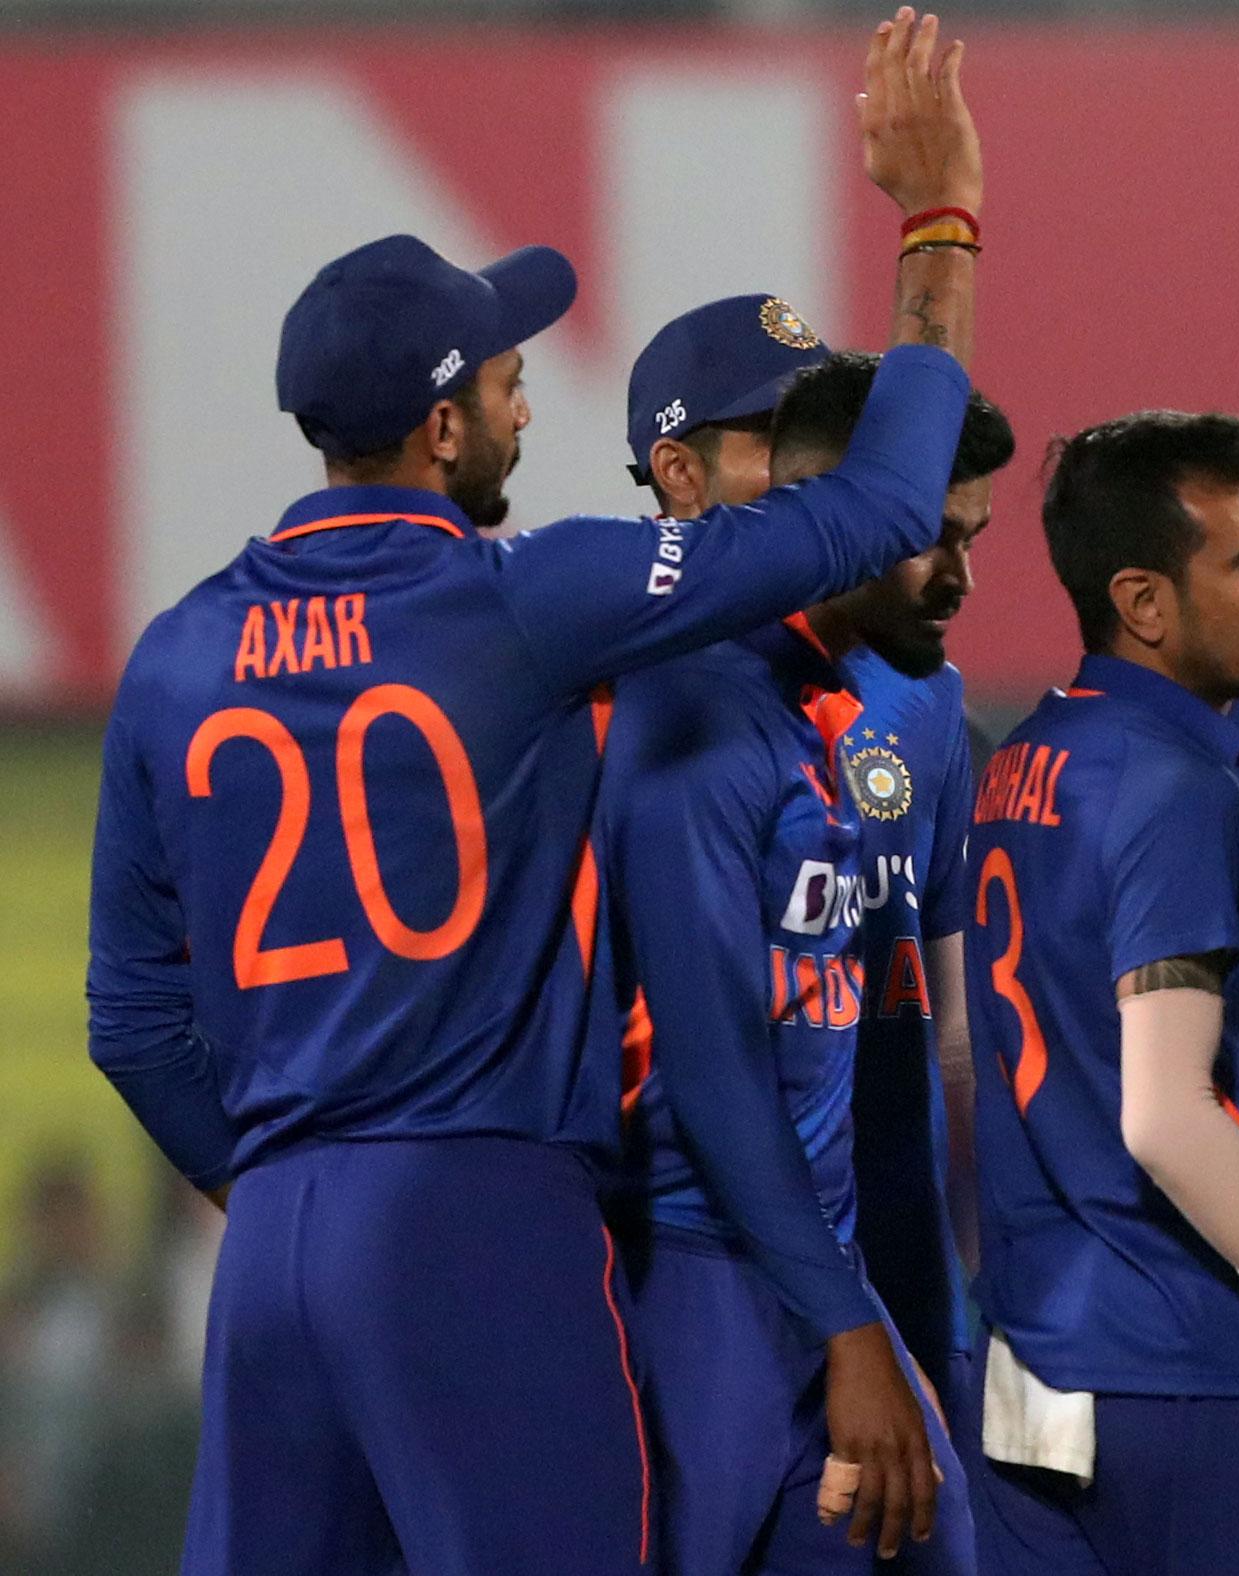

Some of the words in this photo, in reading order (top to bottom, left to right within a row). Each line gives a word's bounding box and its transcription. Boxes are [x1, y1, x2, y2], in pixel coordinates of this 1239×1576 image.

[431, 348, 466, 387] 202
[655, 398, 688, 435] 235
[235, 592, 373, 684] AXAR
[185, 682, 490, 991] 20
[975, 847, 1049, 1120] 3
